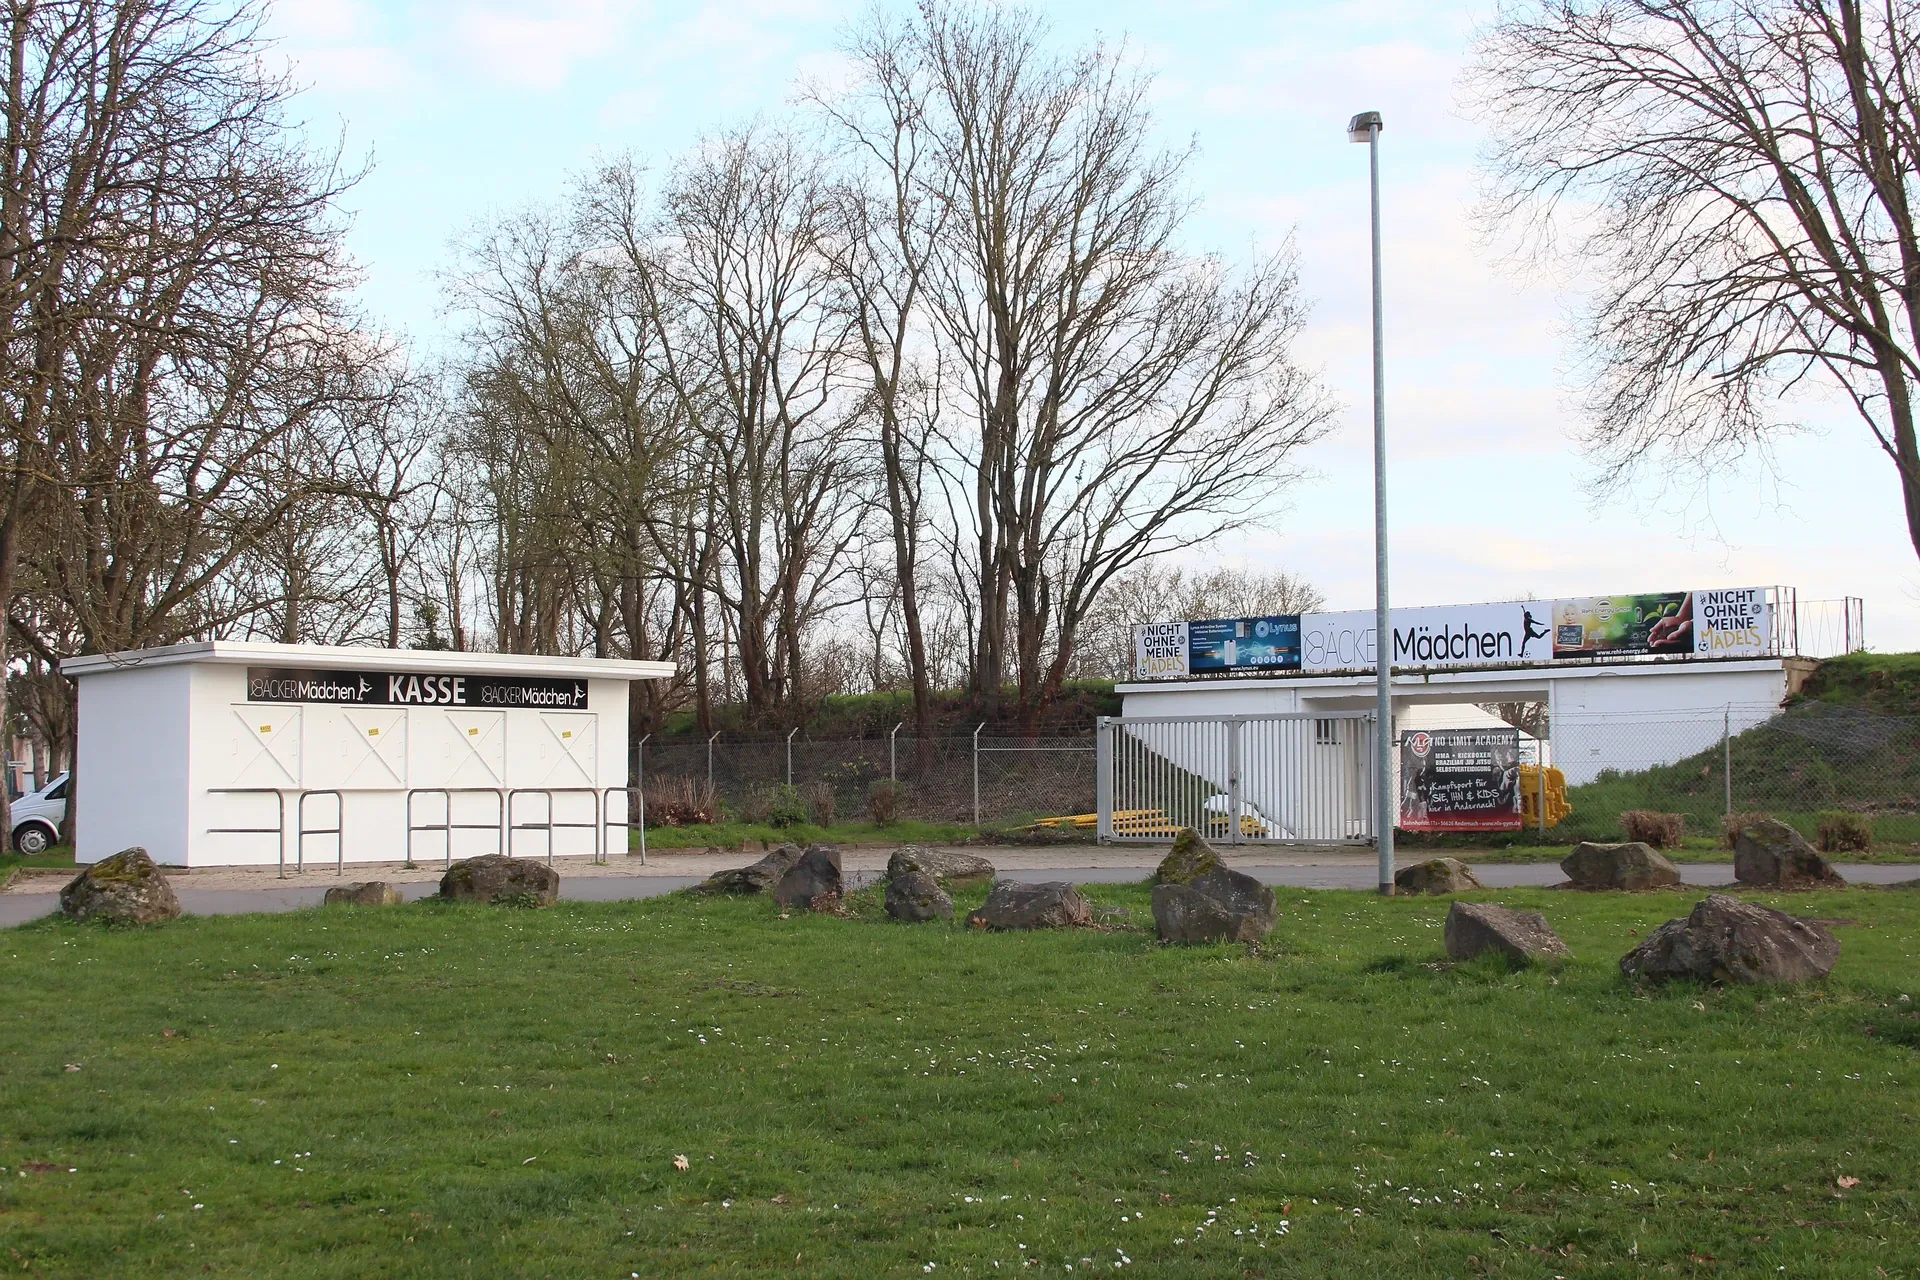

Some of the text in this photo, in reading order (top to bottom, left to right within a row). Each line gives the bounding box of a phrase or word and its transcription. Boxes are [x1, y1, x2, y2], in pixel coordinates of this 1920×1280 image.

[1704, 604, 1747, 617] OHNE
[1269, 622, 1298, 635] Lynus
[1707, 617, 1754, 630] MEINE
[1144, 636, 1175, 647] OHNE
[1303, 622, 1512, 664] BÄCKE Mädchen
[1701, 626, 1761, 649] MÄDELS
[1146, 647, 1180, 658] MEINE
[1142, 655, 1185, 675] MÄDELS
[298, 681, 355, 700] Mädchen
[388, 675, 466, 704] KASSE
[522, 688, 571, 705] Mädchen
[1435, 734, 1514, 746] NO LIMIT ACADEMY
[1431, 779, 1487, 792] Kampfsport für
[1432, 793, 1448, 803] SIE,
[1451, 791, 1463, 800] IHN
[1477, 789, 1499, 799] KIDS
[1454, 798, 1495, 810] Andernach!
